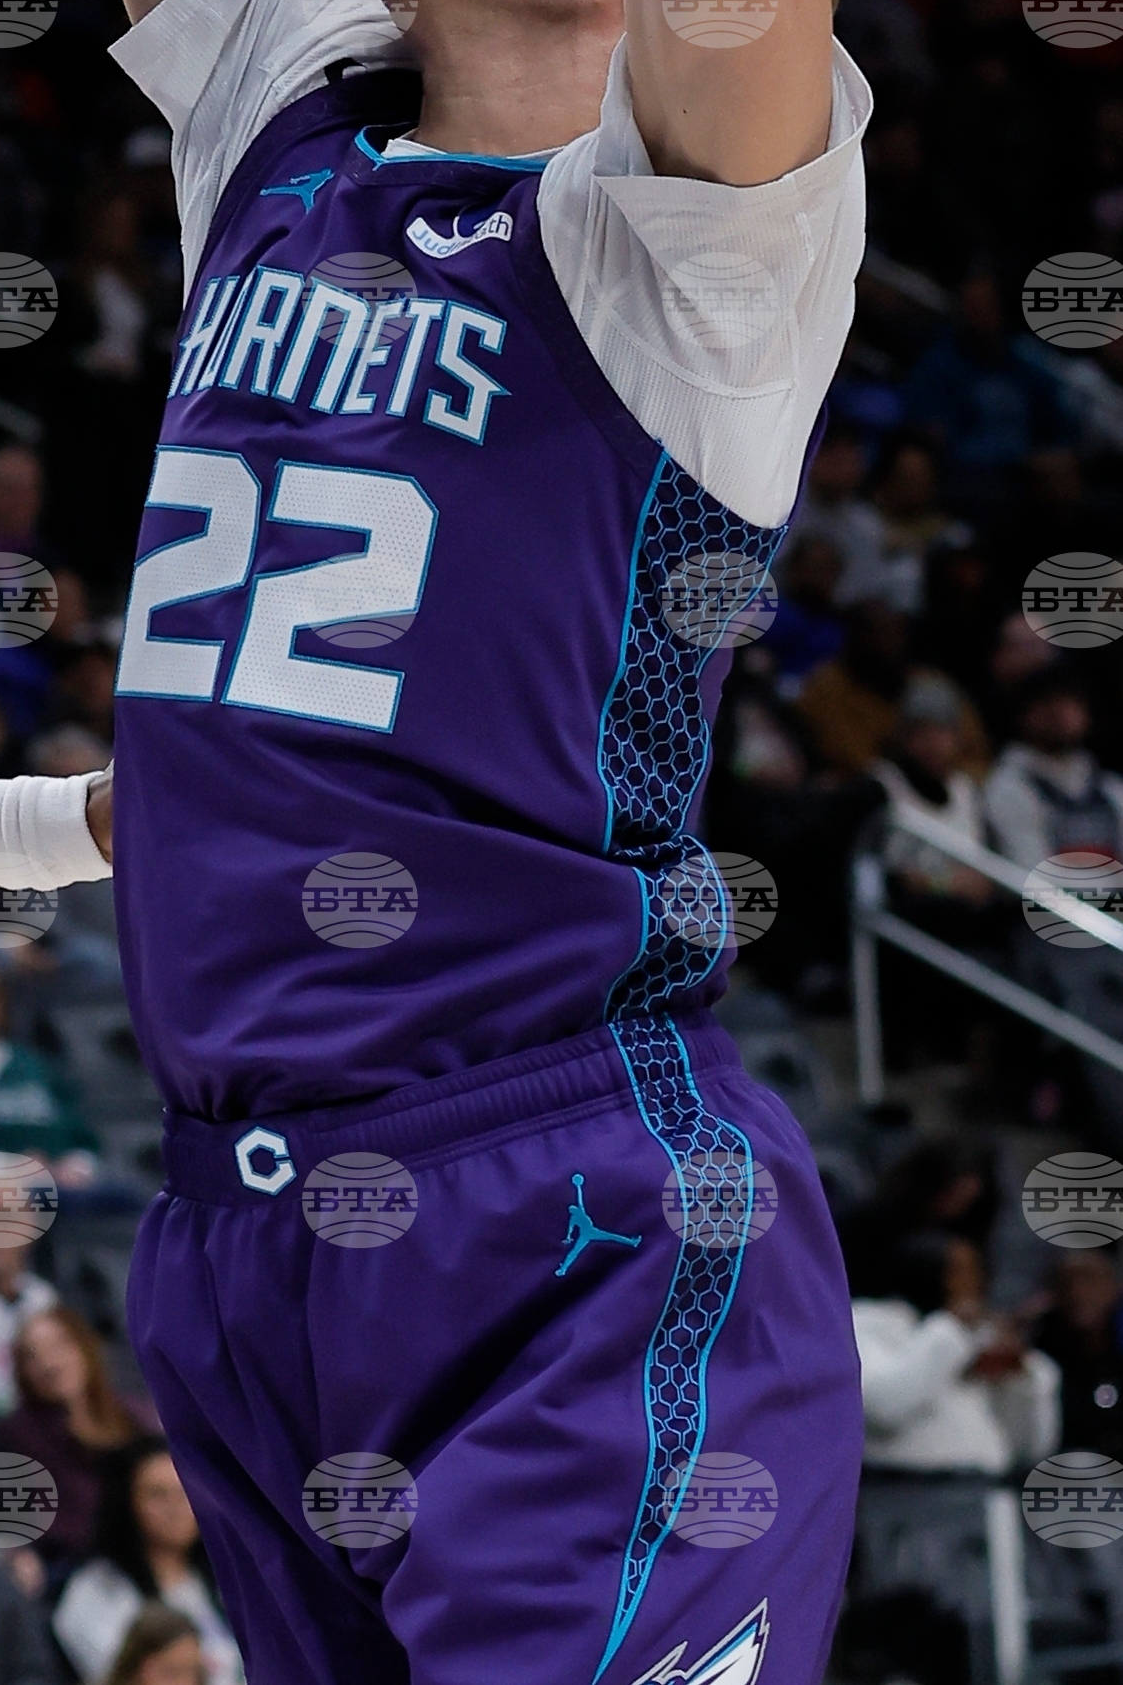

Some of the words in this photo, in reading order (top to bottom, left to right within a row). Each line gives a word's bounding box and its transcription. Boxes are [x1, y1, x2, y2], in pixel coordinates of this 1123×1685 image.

[168, 265, 512, 446] HORNETS
[115, 444, 439, 735] 22
[234, 1126, 297, 1196] C
